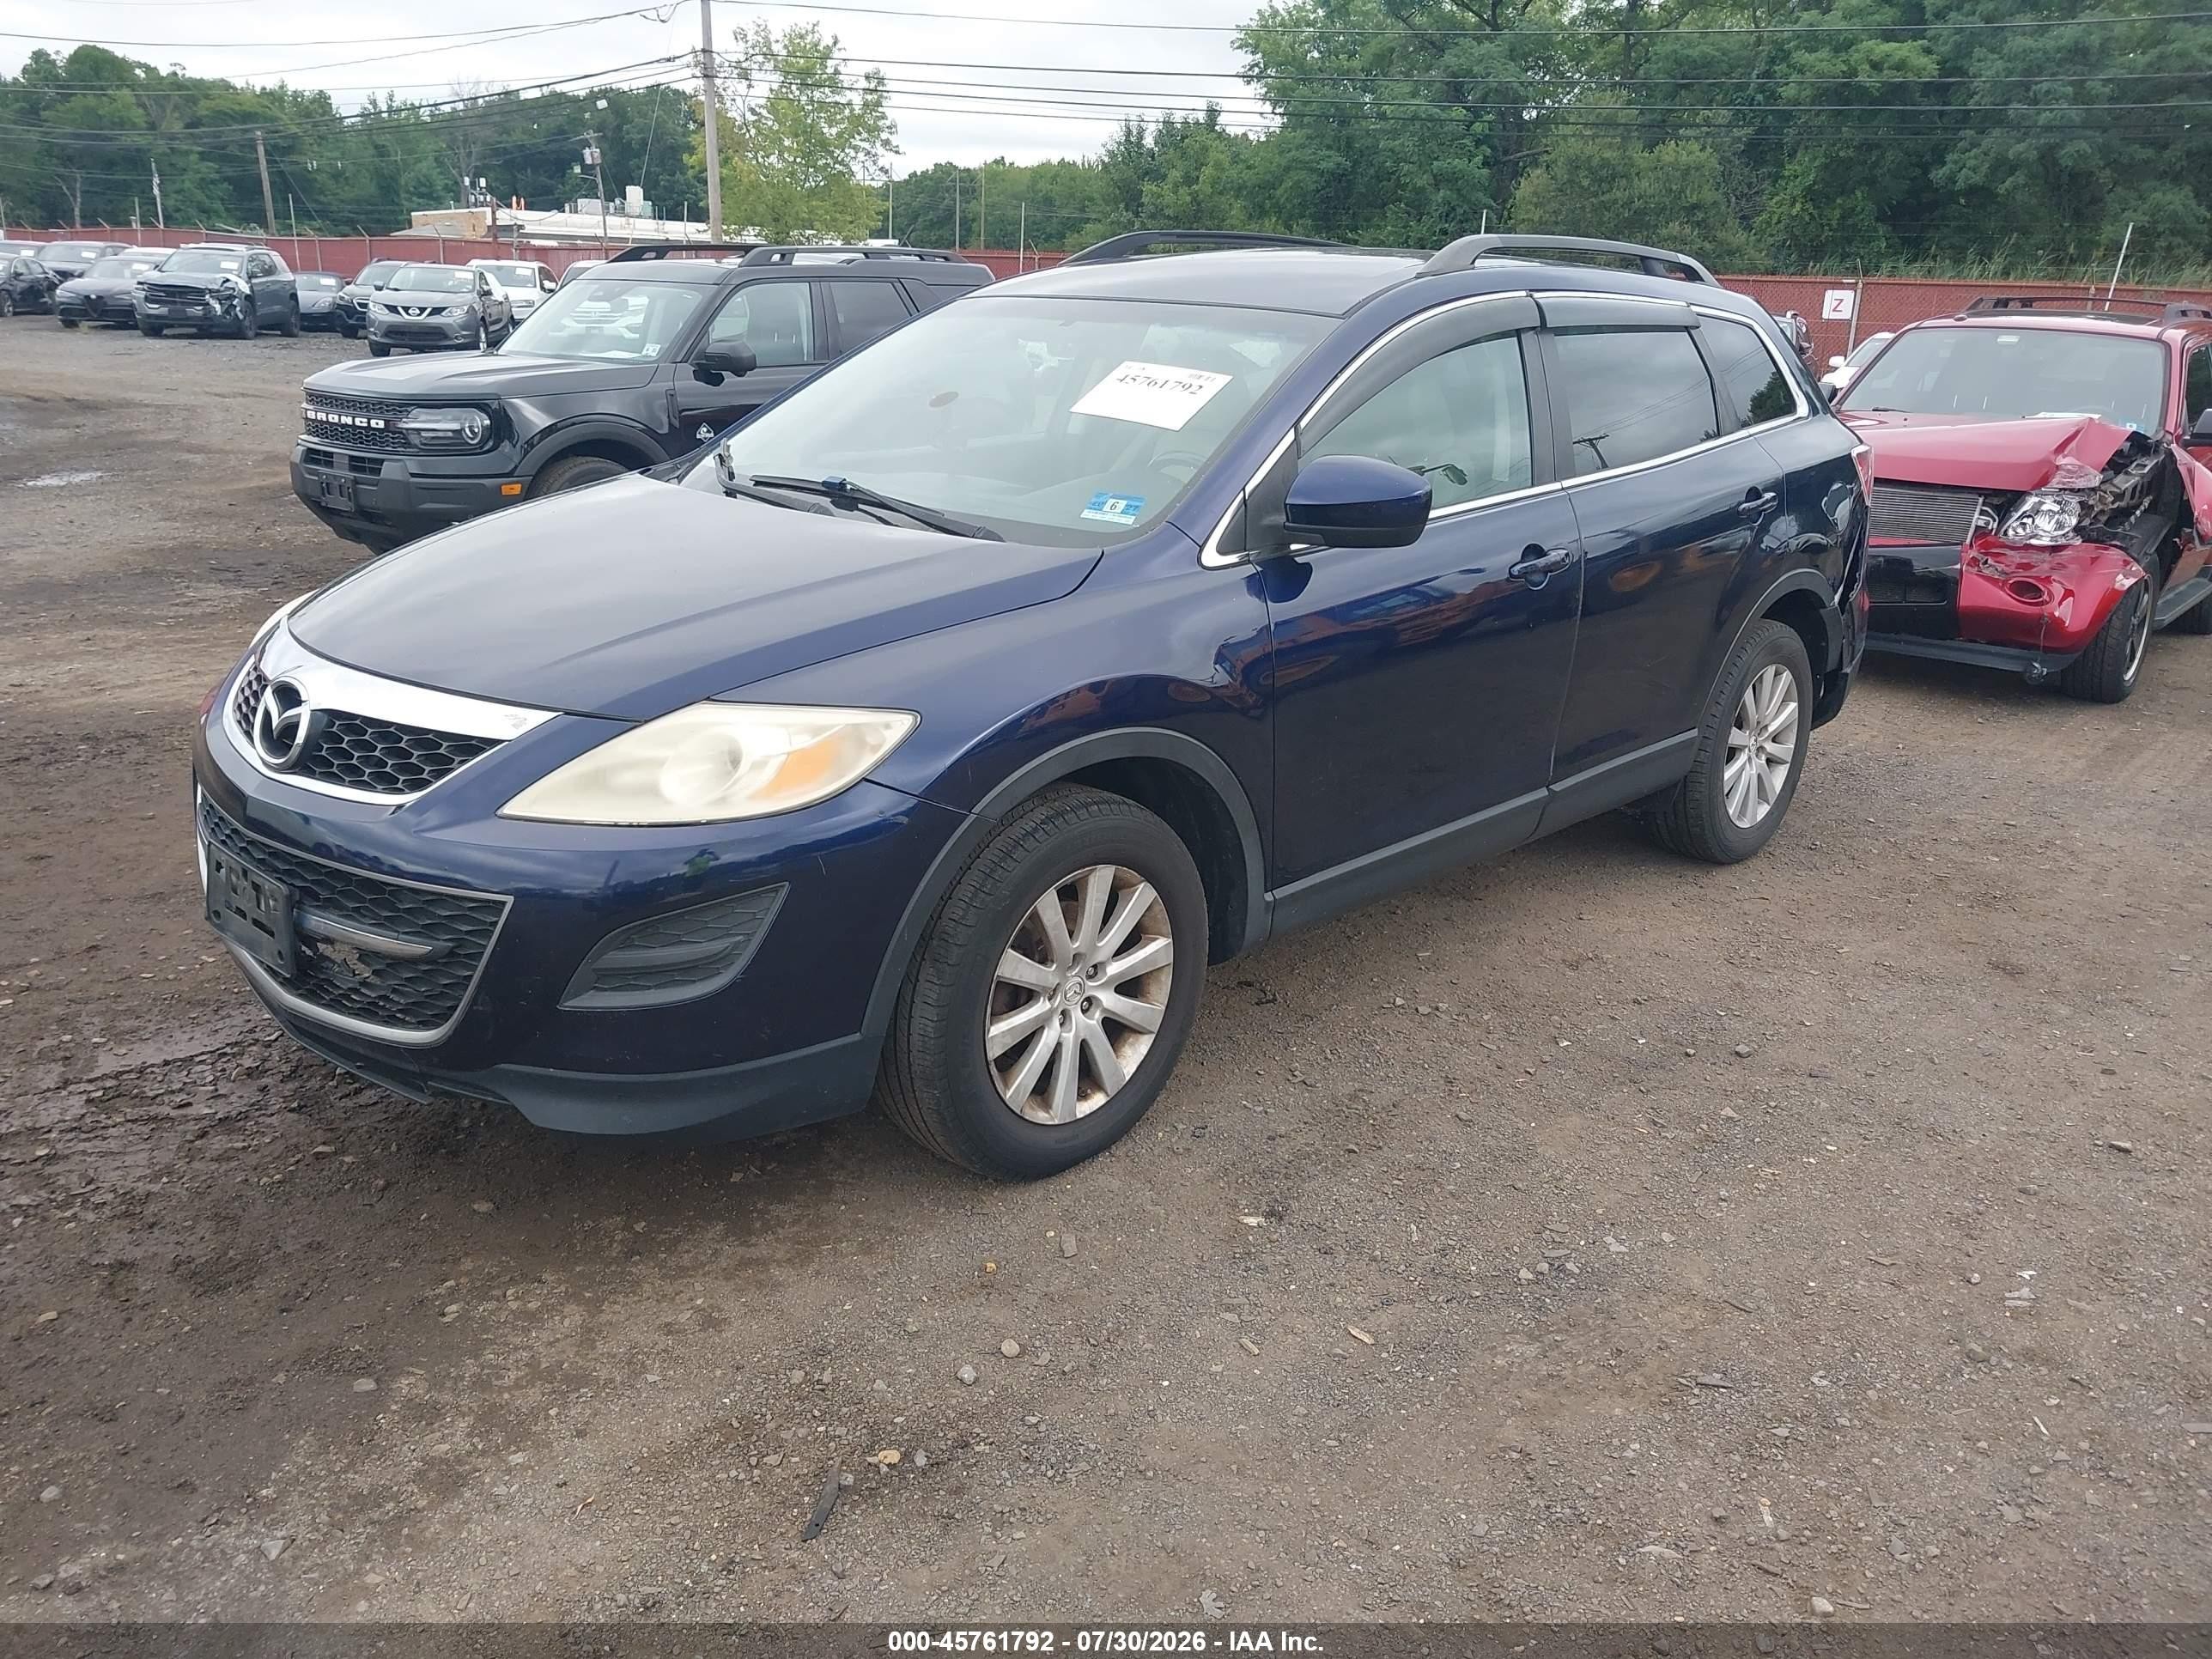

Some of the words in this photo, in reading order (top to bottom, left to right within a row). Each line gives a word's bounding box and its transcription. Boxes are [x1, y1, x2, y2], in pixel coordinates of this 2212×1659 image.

[1832, 298, 1845, 313] Z
[1116, 374, 1204, 395] 45761792
[307, 410, 386, 428] BRONCO
[1109, 501, 1120, 511] 6
